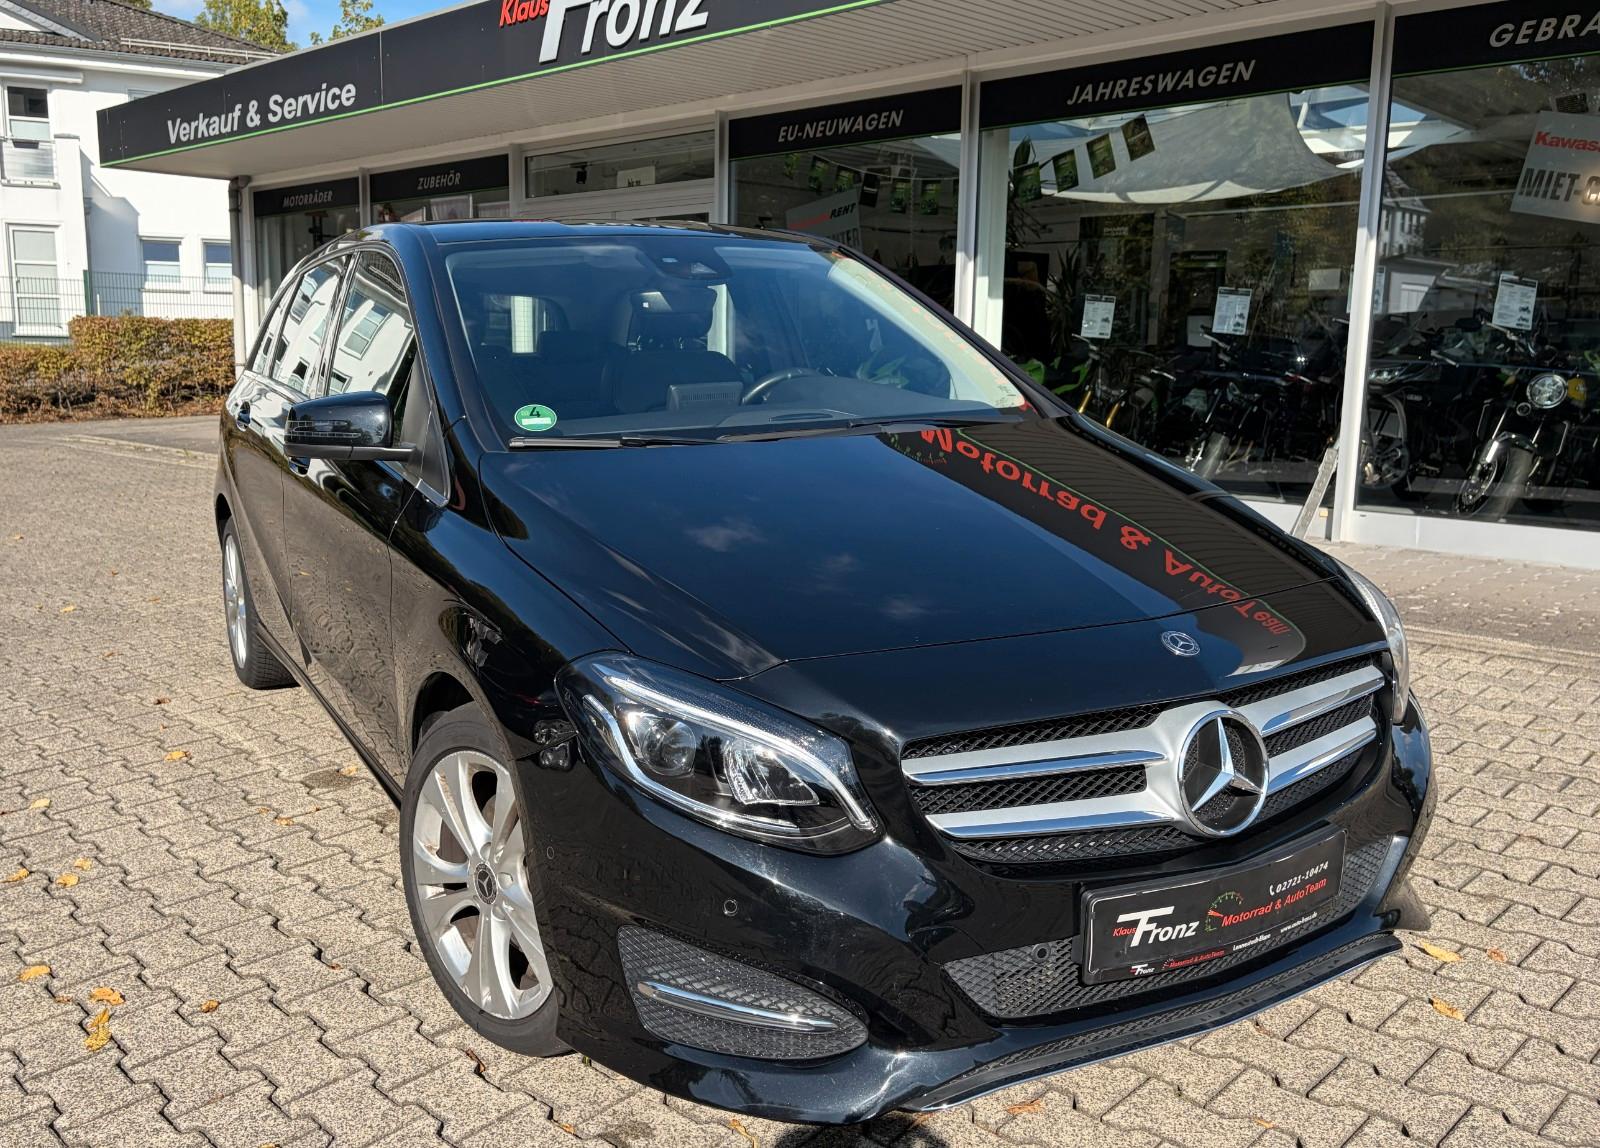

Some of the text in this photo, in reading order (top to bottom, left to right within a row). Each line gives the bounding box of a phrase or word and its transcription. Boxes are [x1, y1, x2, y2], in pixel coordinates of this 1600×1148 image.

[499, 0, 709, 63] Klaus Fronz
[1066, 59, 1256, 106] JAHRESWAGEN
[167, 82, 356, 145] Verkauf & Service
[778, 109, 904, 143] EU-NEUWAGEN
[1535, 131, 1600, 152] Kawas
[417, 170, 461, 190] ZUBEHÖR
[282, 189, 333, 208] MOTORRÄDER
[829, 202, 856, 219] RENT
[529, 406, 541, 418] 4
[1275, 860, 1329, 894] 02721-10474
[1113, 906, 1200, 948] Klaus Fronz
[1221, 902, 1273, 927] Motorrad
[1274, 899, 1282, 910] &
